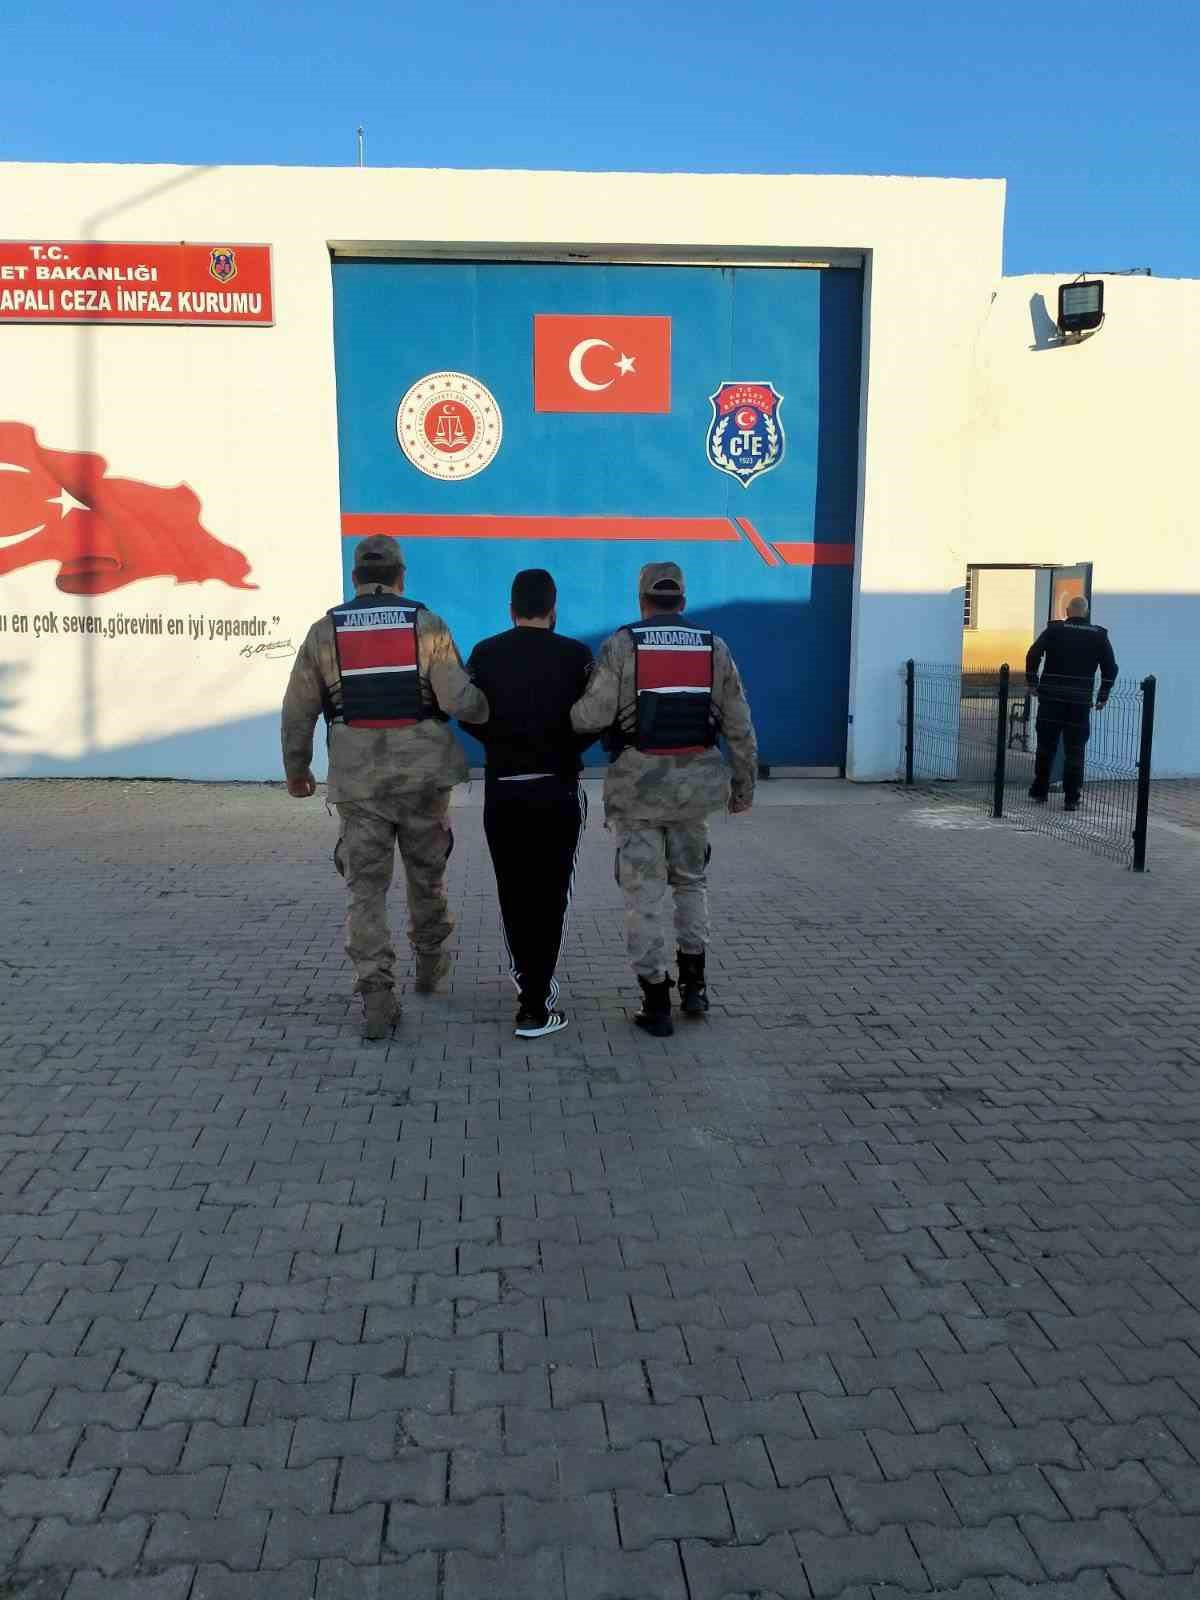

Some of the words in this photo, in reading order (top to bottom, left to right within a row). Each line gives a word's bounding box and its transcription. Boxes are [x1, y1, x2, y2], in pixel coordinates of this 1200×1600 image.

[30, 246, 69, 260] T.C.
[36, 265, 158, 282] BAKANLIĞI
[61, 289, 112, 312] CEZA
[117, 286, 173, 312] İNFAZ
[179, 291, 262, 314] KURUMU
[730, 430, 762, 456] CTE
[12, 614, 28, 633] en
[33, 611, 59, 638] çok
[167, 617, 184, 635] en
[188, 614, 204, 640] iyi
[343, 611, 407, 627] JANDARMA
[642, 631, 704, 646] JANDARMA
